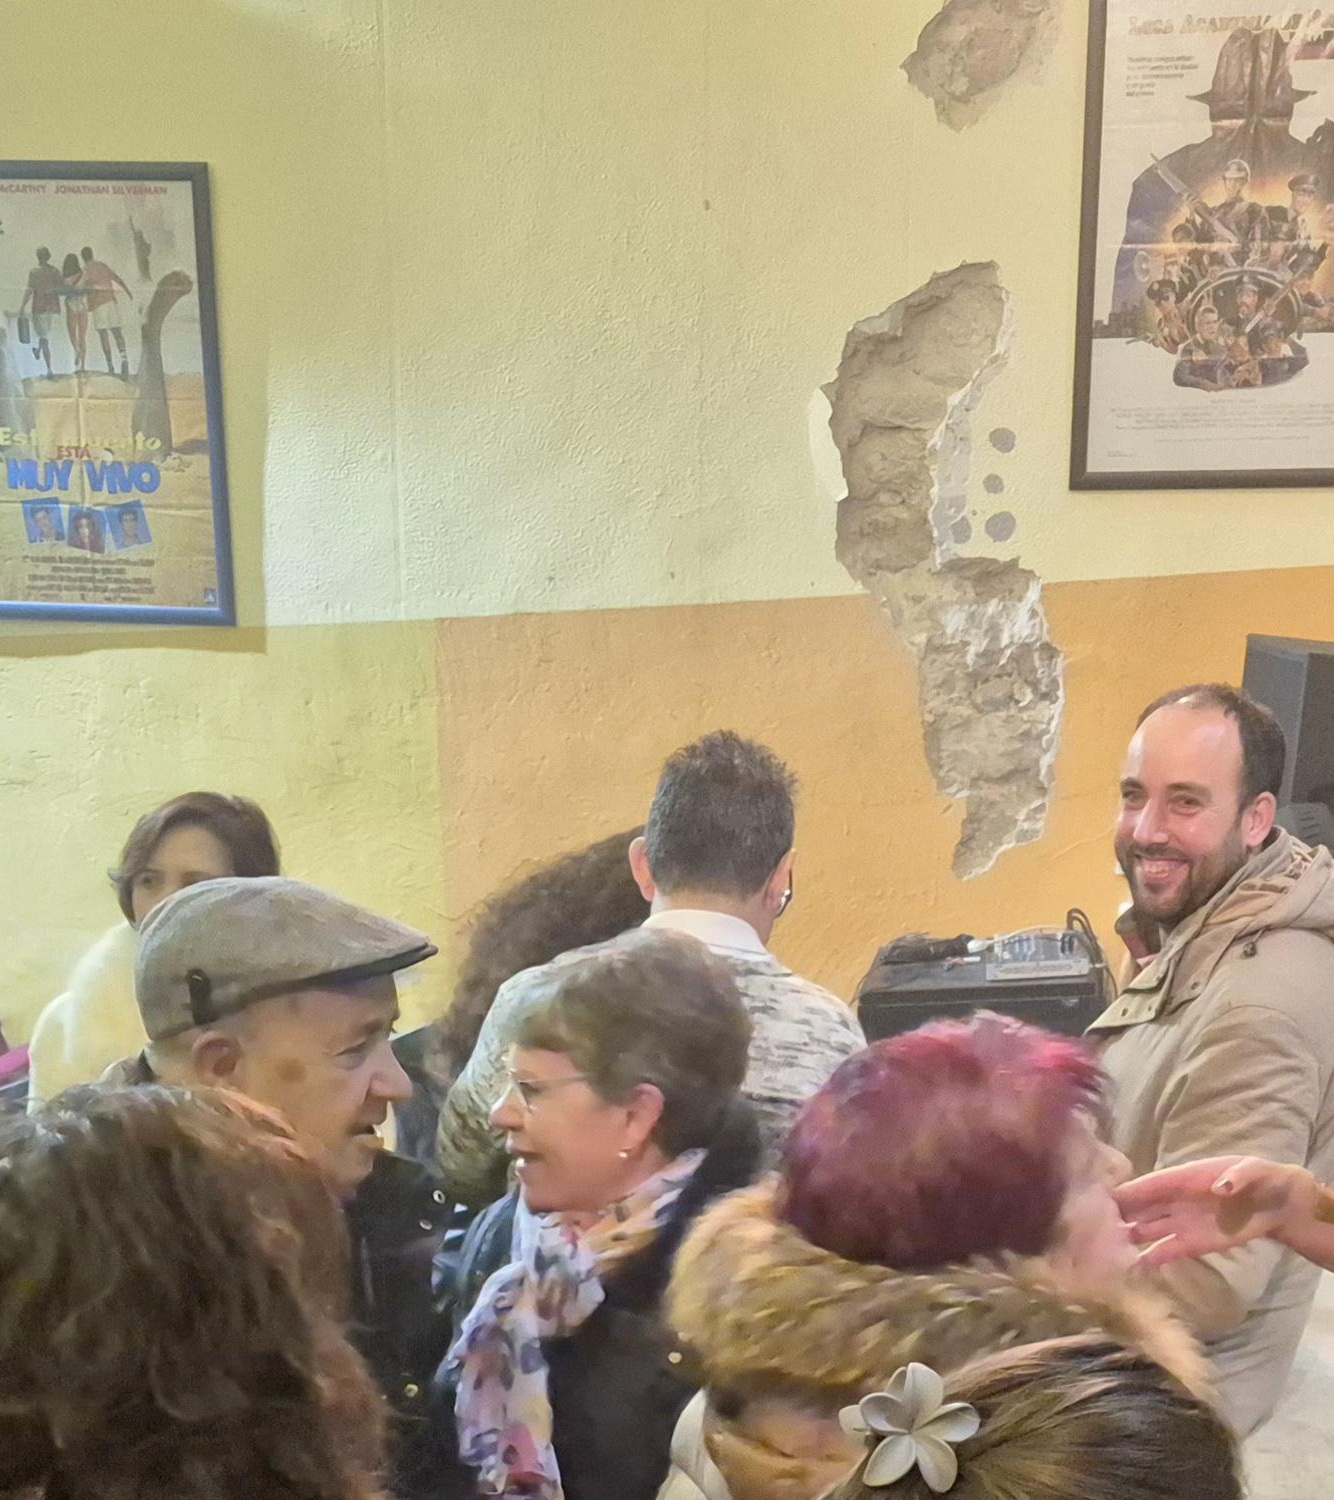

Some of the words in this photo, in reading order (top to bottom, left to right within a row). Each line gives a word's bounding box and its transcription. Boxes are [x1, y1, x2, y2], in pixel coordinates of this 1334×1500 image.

[54, 184, 109, 195] JONATHAN
[6, 458, 74, 492] MUY
[84, 459, 161, 494] VIVO
